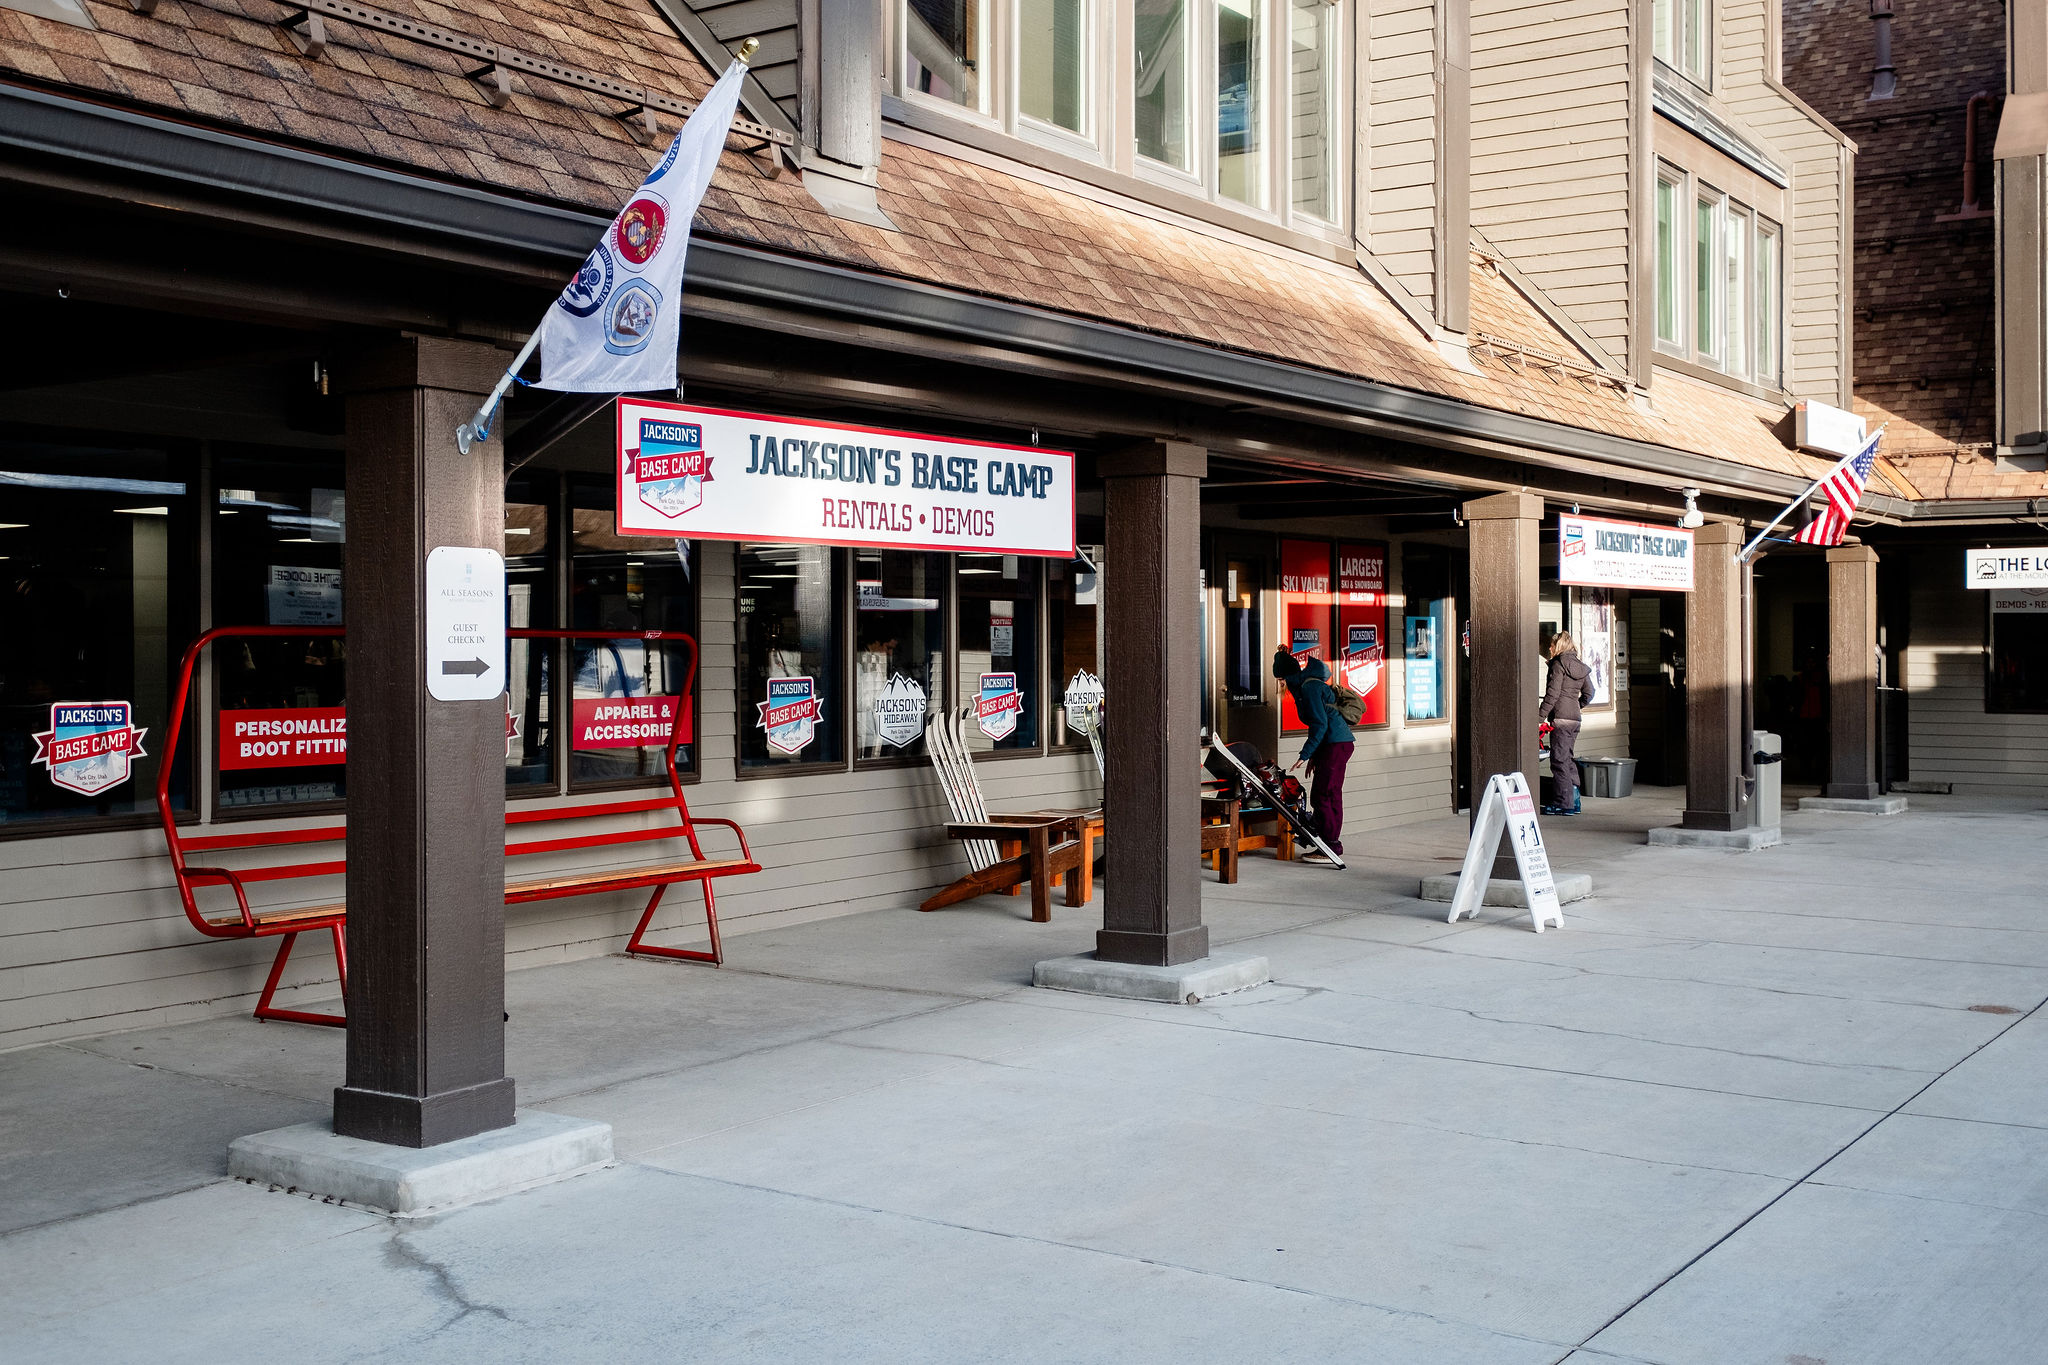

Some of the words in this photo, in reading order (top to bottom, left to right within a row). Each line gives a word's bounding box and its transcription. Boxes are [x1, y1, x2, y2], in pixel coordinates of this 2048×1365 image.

[599, 246, 613, 276] UNITED
[597, 278, 612, 306] STATES
[643, 423, 698, 443] JACKSON'S
[640, 459, 669, 479] BASE
[671, 455, 701, 474] CAMP
[746, 434, 901, 487] JACKSON'S
[911, 452, 979, 494] BASE
[987, 460, 1054, 499] CAMP
[821, 497, 912, 532] RENTALS
[932, 506, 995, 537] DEMOS
[1595, 529, 1640, 554] JACKSON'S
[1642, 535, 1664, 556] BASE
[1665, 538, 1688, 558] CAMP
[1339, 557, 1383, 577] LARGEST
[1998, 557, 2029, 572] THE
[1283, 575, 1299, 592] SKI
[1301, 576, 1329, 594] VALET
[1341, 579, 1350, 589] SKI
[1350, 580, 1354, 588] &
[1354, 580, 1383, 590] SNOWBOARD
[441, 589, 456, 597] ALL
[458, 589, 494, 598] SEASONS
[1995, 600, 2027, 609] DEMOS
[2034, 600, 2048, 609] RE
[452, 623, 479, 632] GUEST
[1293, 630, 1319, 641] JACKSON'S
[1350, 630, 1375, 641] JACKSON'S
[447, 635, 475, 644] CHECK
[476, 635, 486, 644] IN
[771, 683, 809, 695] JACKSON'S
[983, 677, 1013, 689] JACKSON'S
[875, 698, 926, 713] JACKSON'S
[981, 701, 997, 715] BASE
[998, 695, 1015, 710] CAMP
[1064, 691, 1105, 705] JACKSON'S
[59, 709, 123, 724] JACKSON'S
[594, 705, 657, 720] APPAREL
[661, 704, 671, 718] &
[770, 708, 790, 725] BASE
[791, 701, 812, 718] CAMP
[883, 713, 919, 724] HIDEAWAY
[583, 722, 673, 741] ACCESSORIE
[55, 739, 88, 760] BASE
[92, 732, 127, 752] CAMP
[240, 740, 291, 757] BOOT
